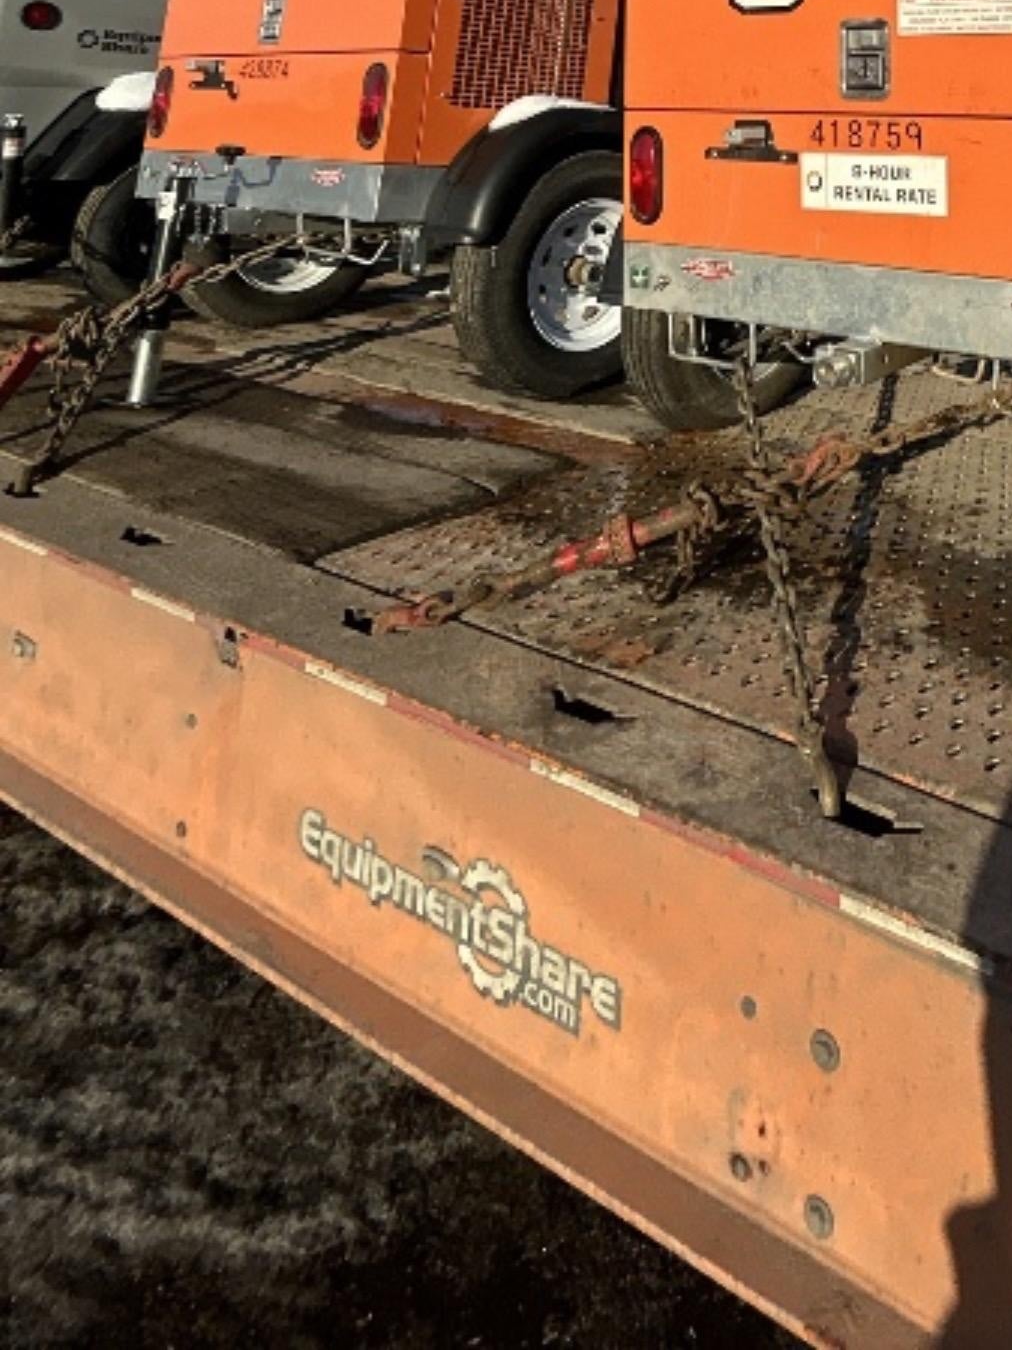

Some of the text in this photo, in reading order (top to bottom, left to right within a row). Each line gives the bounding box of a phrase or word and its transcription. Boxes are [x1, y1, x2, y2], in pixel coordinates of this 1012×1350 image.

[809, 119, 923, 151] 418759
[832, 185, 938, 206] RENTAL RATE
[299, 808, 620, 1026] EquipmentShare
